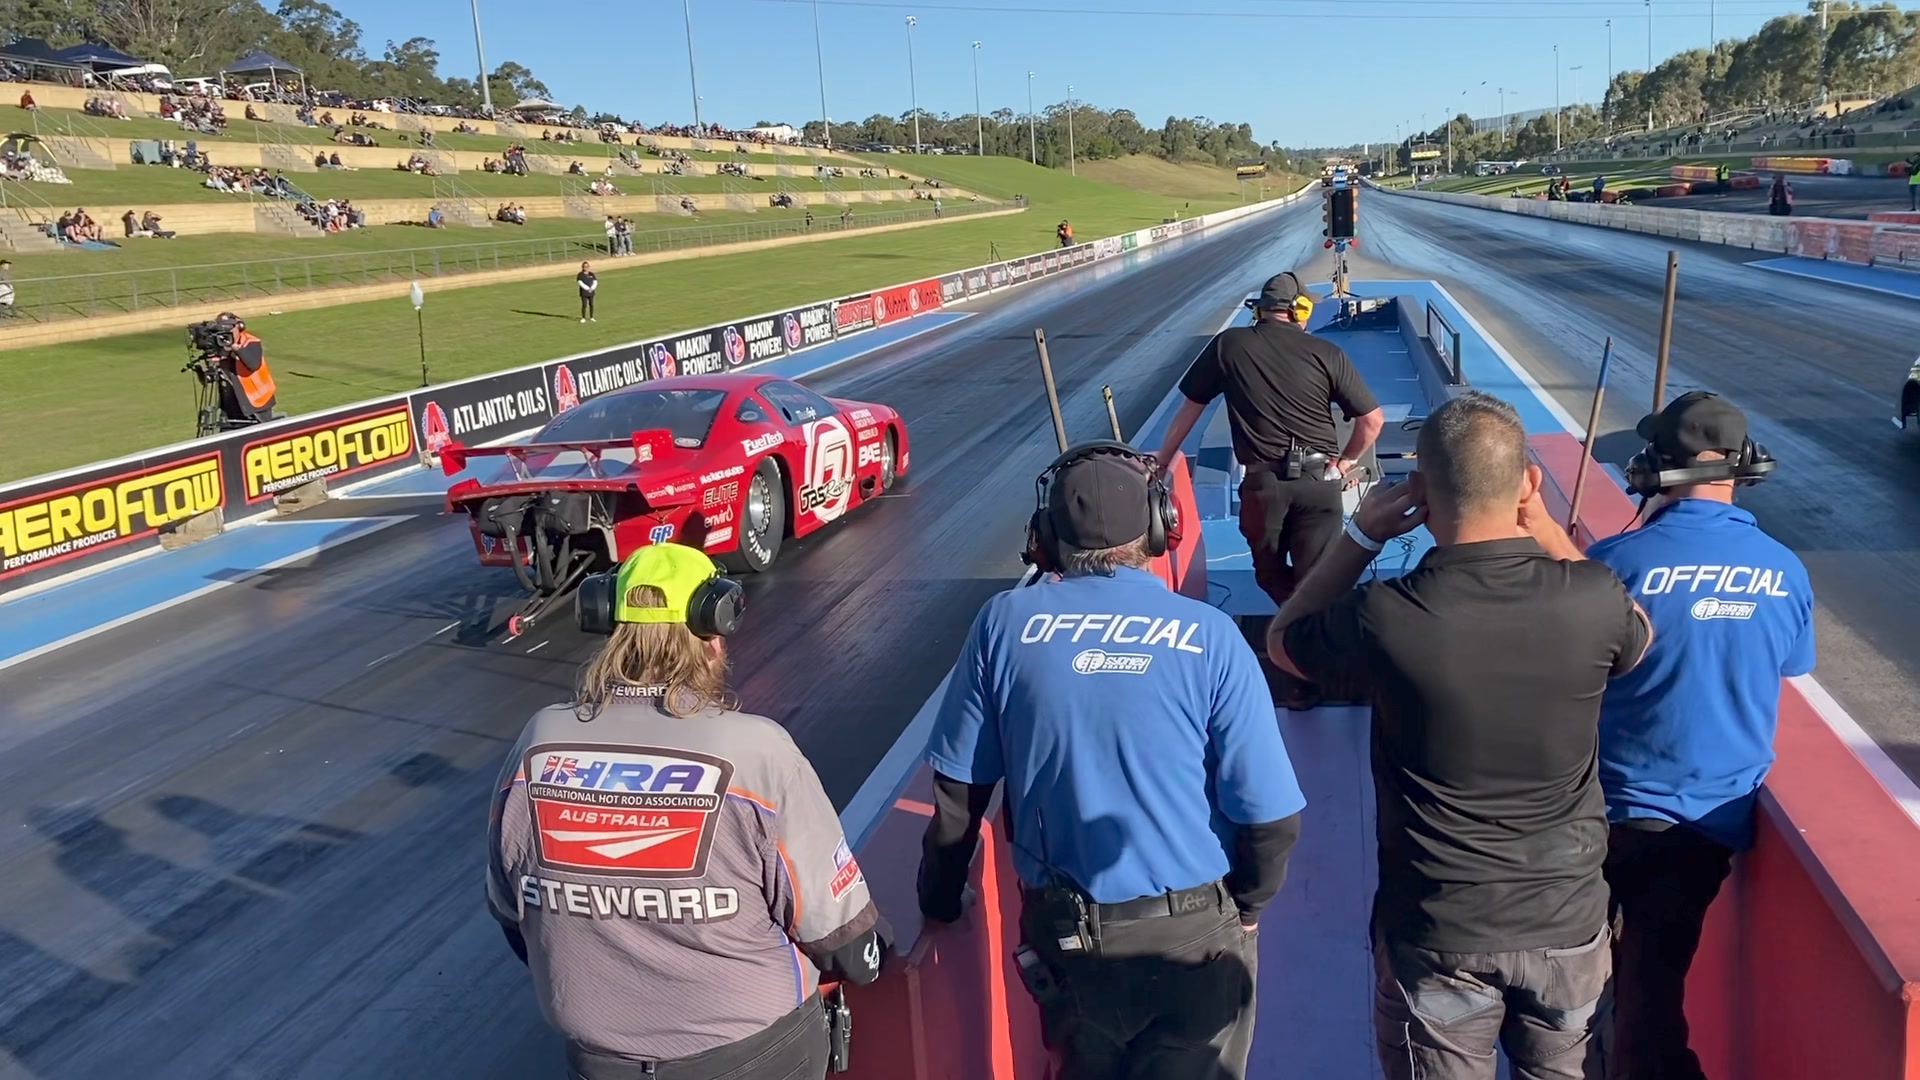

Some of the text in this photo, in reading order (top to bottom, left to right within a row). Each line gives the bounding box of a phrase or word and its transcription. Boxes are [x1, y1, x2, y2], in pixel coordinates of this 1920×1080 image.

[744, 320, 774, 342] MAKIN'
[804, 317, 831, 343] POWER!
[675, 334, 712, 361] MAKIN'
[750, 336, 782, 360] POWER!
[682, 351, 721, 376] POWER!
[578, 358, 644, 398] ATLANTIC OILS
[453, 386, 546, 435] ATLANTIC OILS
[245, 411, 410, 498] AEROFLOW
[742, 432, 785, 460] FuelTech
[262, 464, 339, 494] PERFORMANCE PRODUCTS
[674, 482, 696, 493] MASTER
[703, 481, 738, 506] ELITE
[3, 529, 117, 570] PERFORMANCE PRODUCTS
[1641, 565, 1789, 597] OFFICIAL
[1020, 613, 1204, 654] OFFICIAL
[540, 755, 706, 793] IHRA
[531, 786, 714, 808] INTERNATIONAL HOT ROD ASSOCIATION
[558, 809, 671, 828] AUSTRALIA
[520, 875, 740, 922] STEWARD
[1171, 893, 1207, 912] Lee
